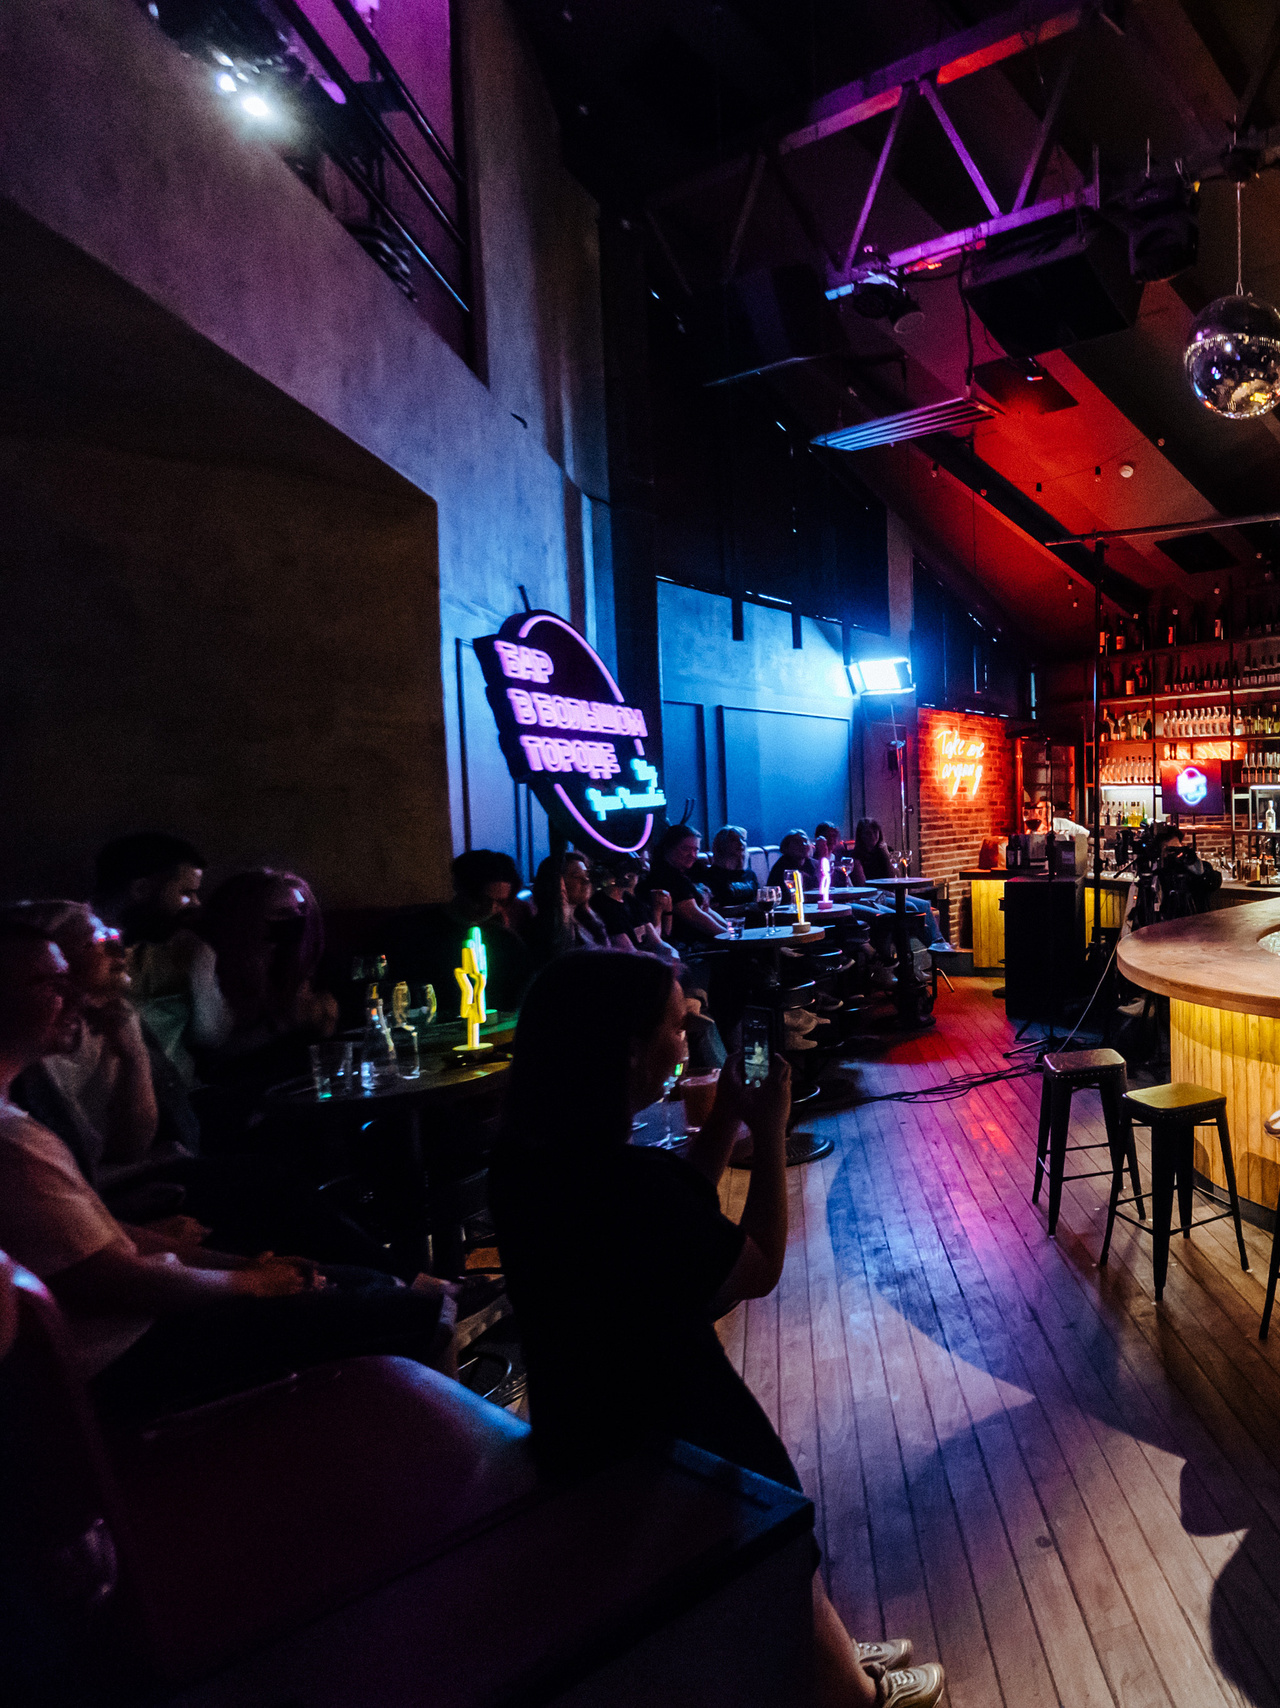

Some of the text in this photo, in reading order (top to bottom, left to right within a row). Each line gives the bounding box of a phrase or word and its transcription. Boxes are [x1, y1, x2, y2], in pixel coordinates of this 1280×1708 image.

[494, 640, 555, 684] БАР
[529, 691, 649, 737] БОЛЬШОМ
[519, 734, 622, 780] ГОРОДЕ
[937, 730, 966, 759] Take
